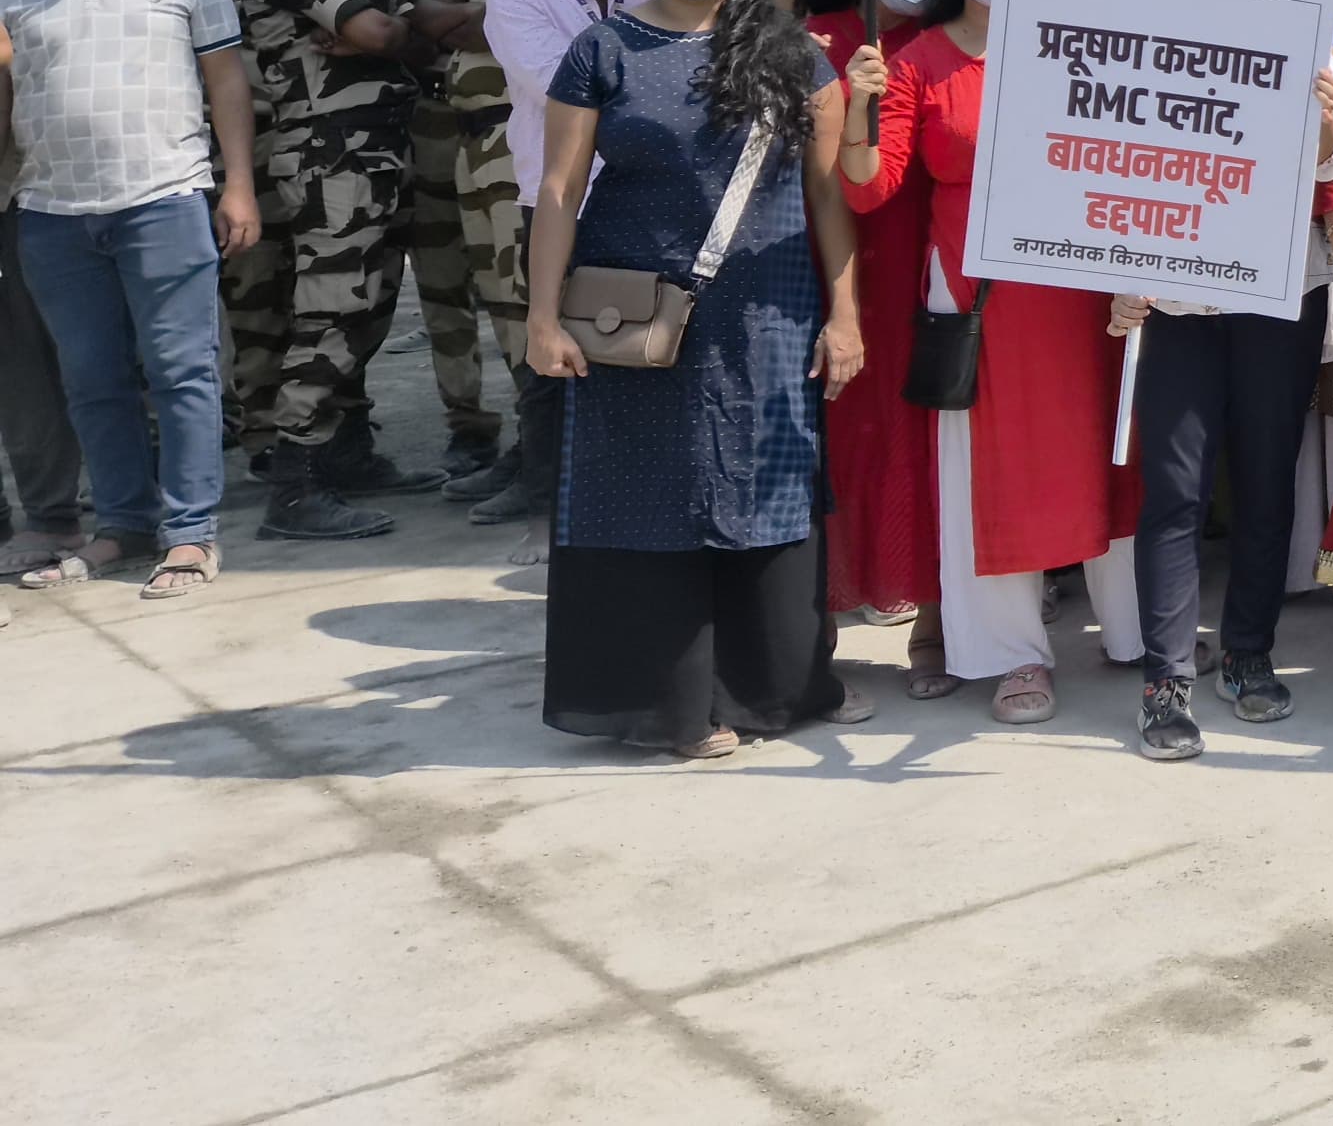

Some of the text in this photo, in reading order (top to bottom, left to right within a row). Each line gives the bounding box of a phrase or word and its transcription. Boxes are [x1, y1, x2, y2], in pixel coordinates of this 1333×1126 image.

[1036, 21, 1289, 91] प्रदूषण करणारा
[1066, 78, 1244, 146] RMC प्लांट,
[1045, 130, 1257, 205] बावधनमधून
[1084, 190, 1203, 242] हद्दपार!
[1012, 237, 1259, 283] नगरसेवक किरण दगडेपाटील
